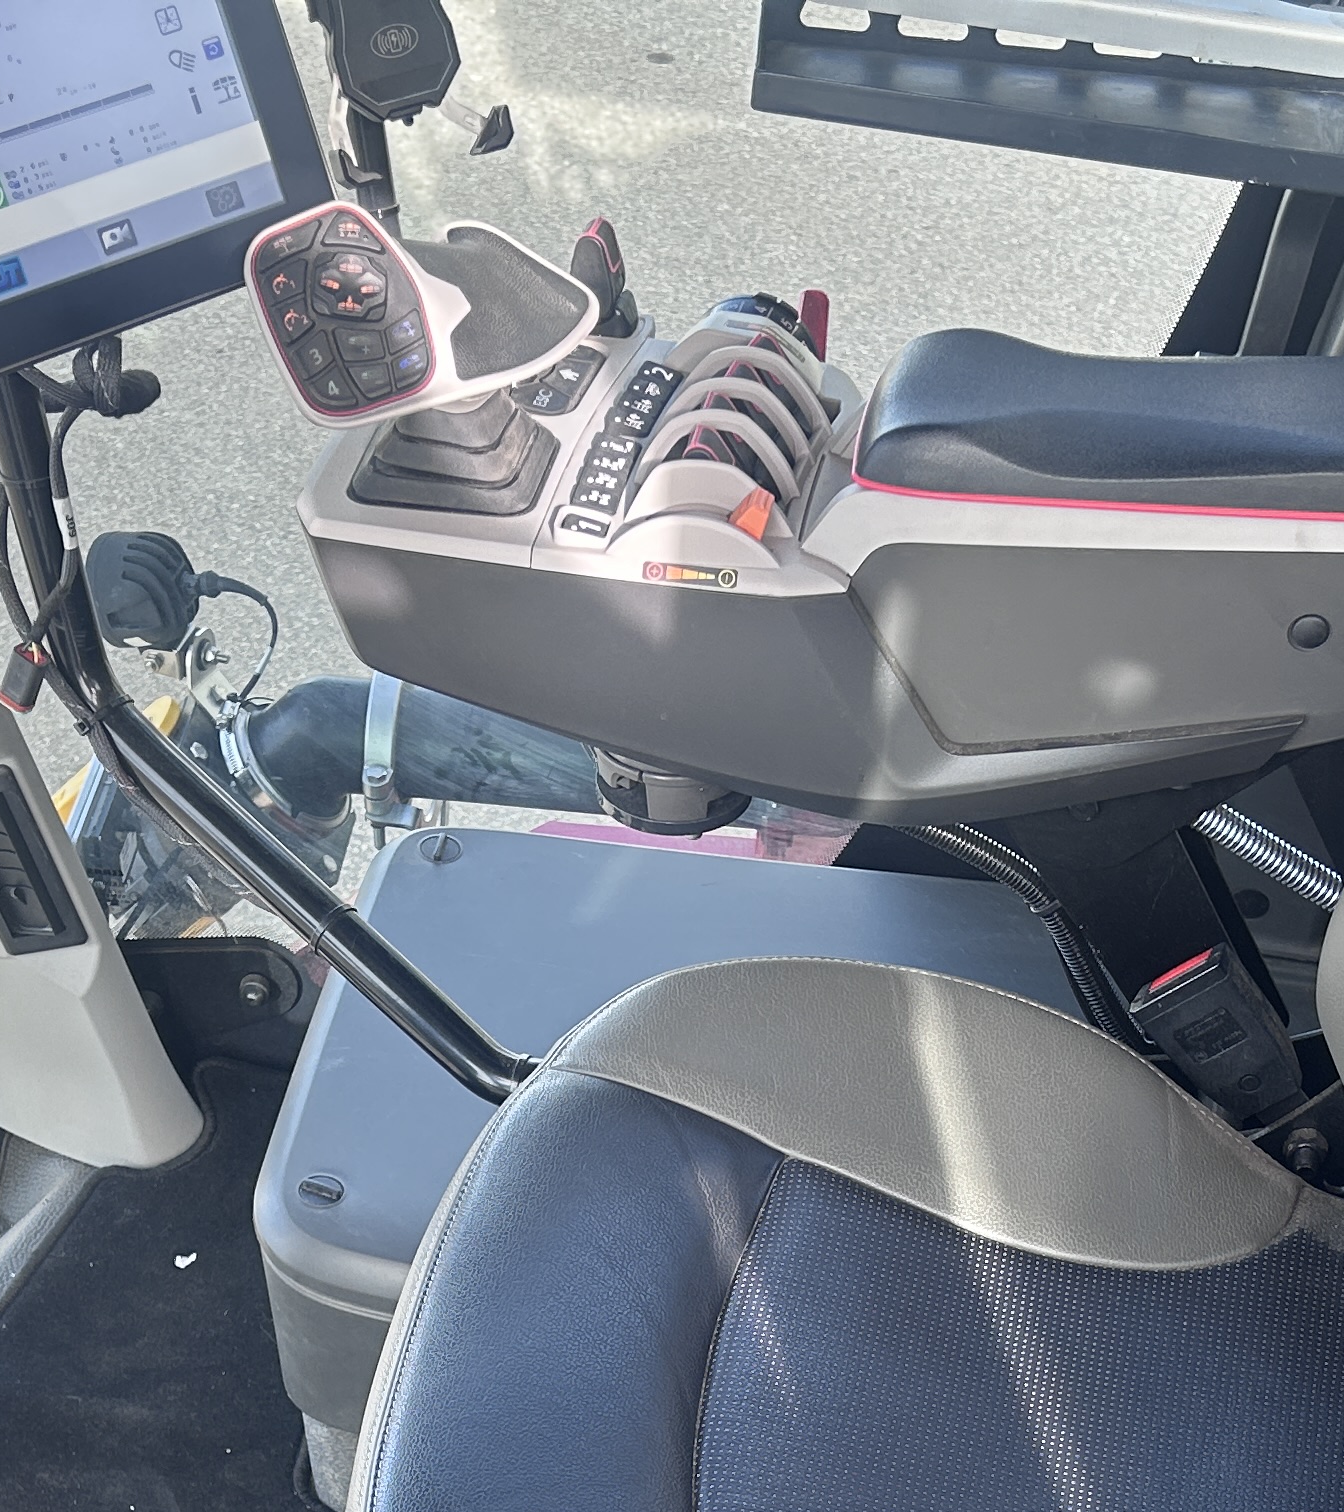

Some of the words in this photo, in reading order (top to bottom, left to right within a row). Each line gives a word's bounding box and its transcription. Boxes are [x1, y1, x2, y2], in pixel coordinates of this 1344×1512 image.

[780, 317, 793, 330] 5
[309, 348, 323, 365] 3
[651, 367, 674, 381] 2
[328, 380, 340, 396] 4
[533, 388, 553, 407] ESC
[578, 520, 602, 532] 1
